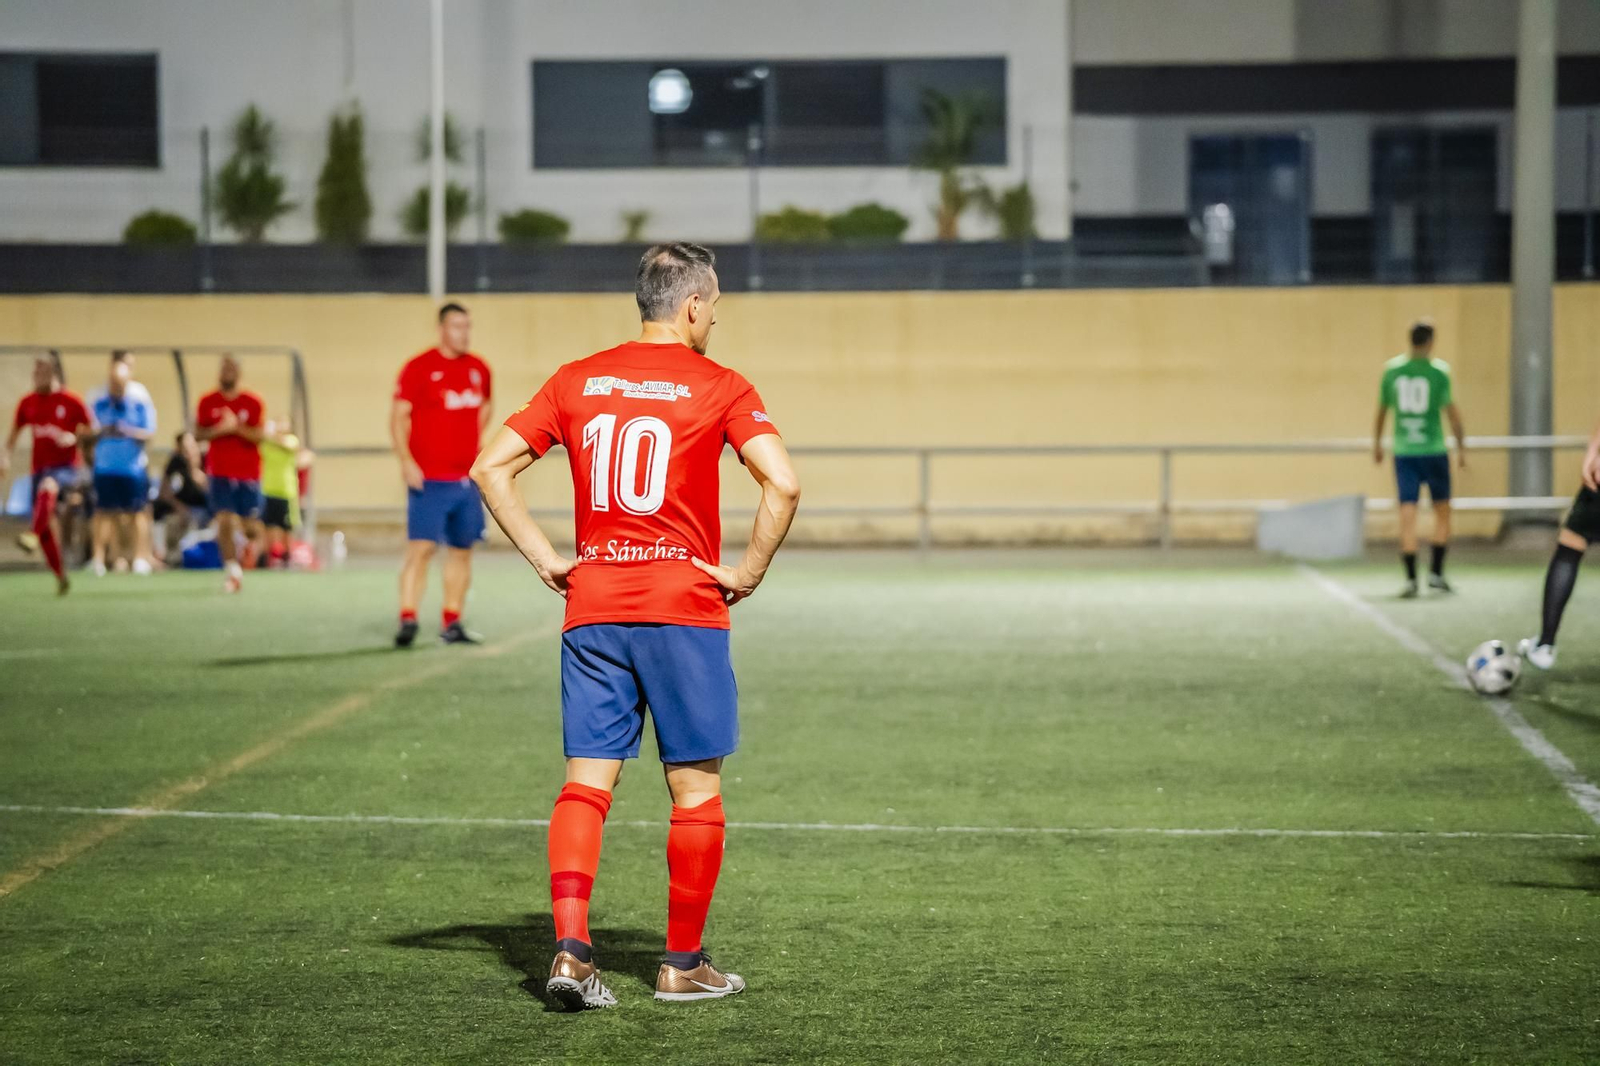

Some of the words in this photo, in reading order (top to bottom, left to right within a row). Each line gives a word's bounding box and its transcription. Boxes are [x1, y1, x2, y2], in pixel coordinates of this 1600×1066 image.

[613, 379, 640, 391] Talleres
[1394, 375, 1430, 414] 10
[583, 413, 673, 516] 10
[604, 536, 688, 561] Sánchez
